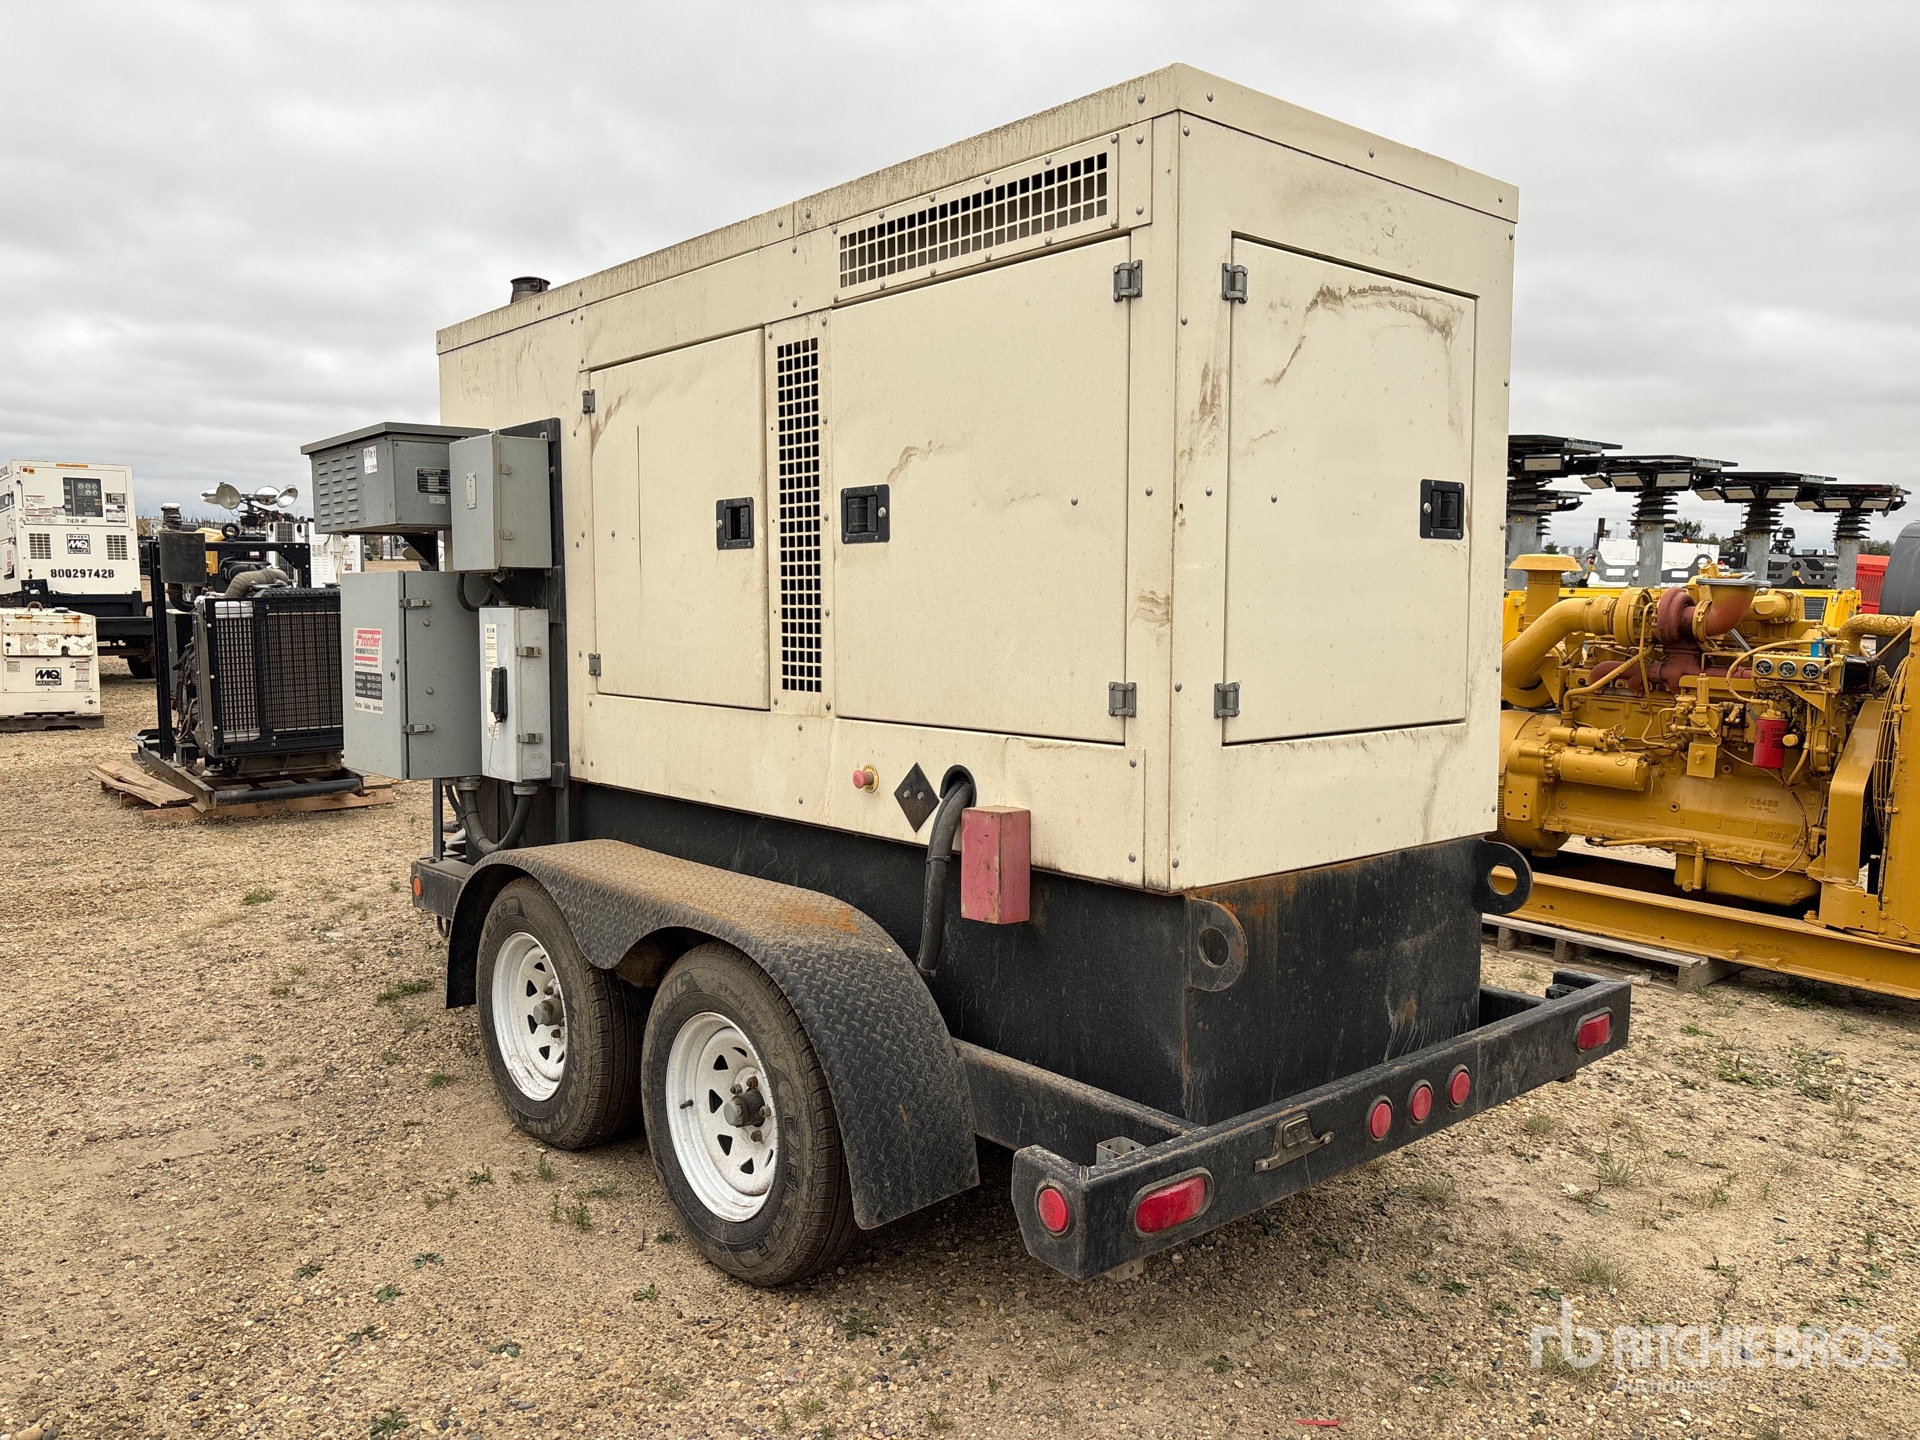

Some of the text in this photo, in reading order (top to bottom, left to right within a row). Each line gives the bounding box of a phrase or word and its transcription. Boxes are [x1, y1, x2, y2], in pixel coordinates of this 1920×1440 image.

[68, 540, 89, 549] MQ
[50, 568, 115, 579] 800297428
[36, 669, 61, 680] MQ
